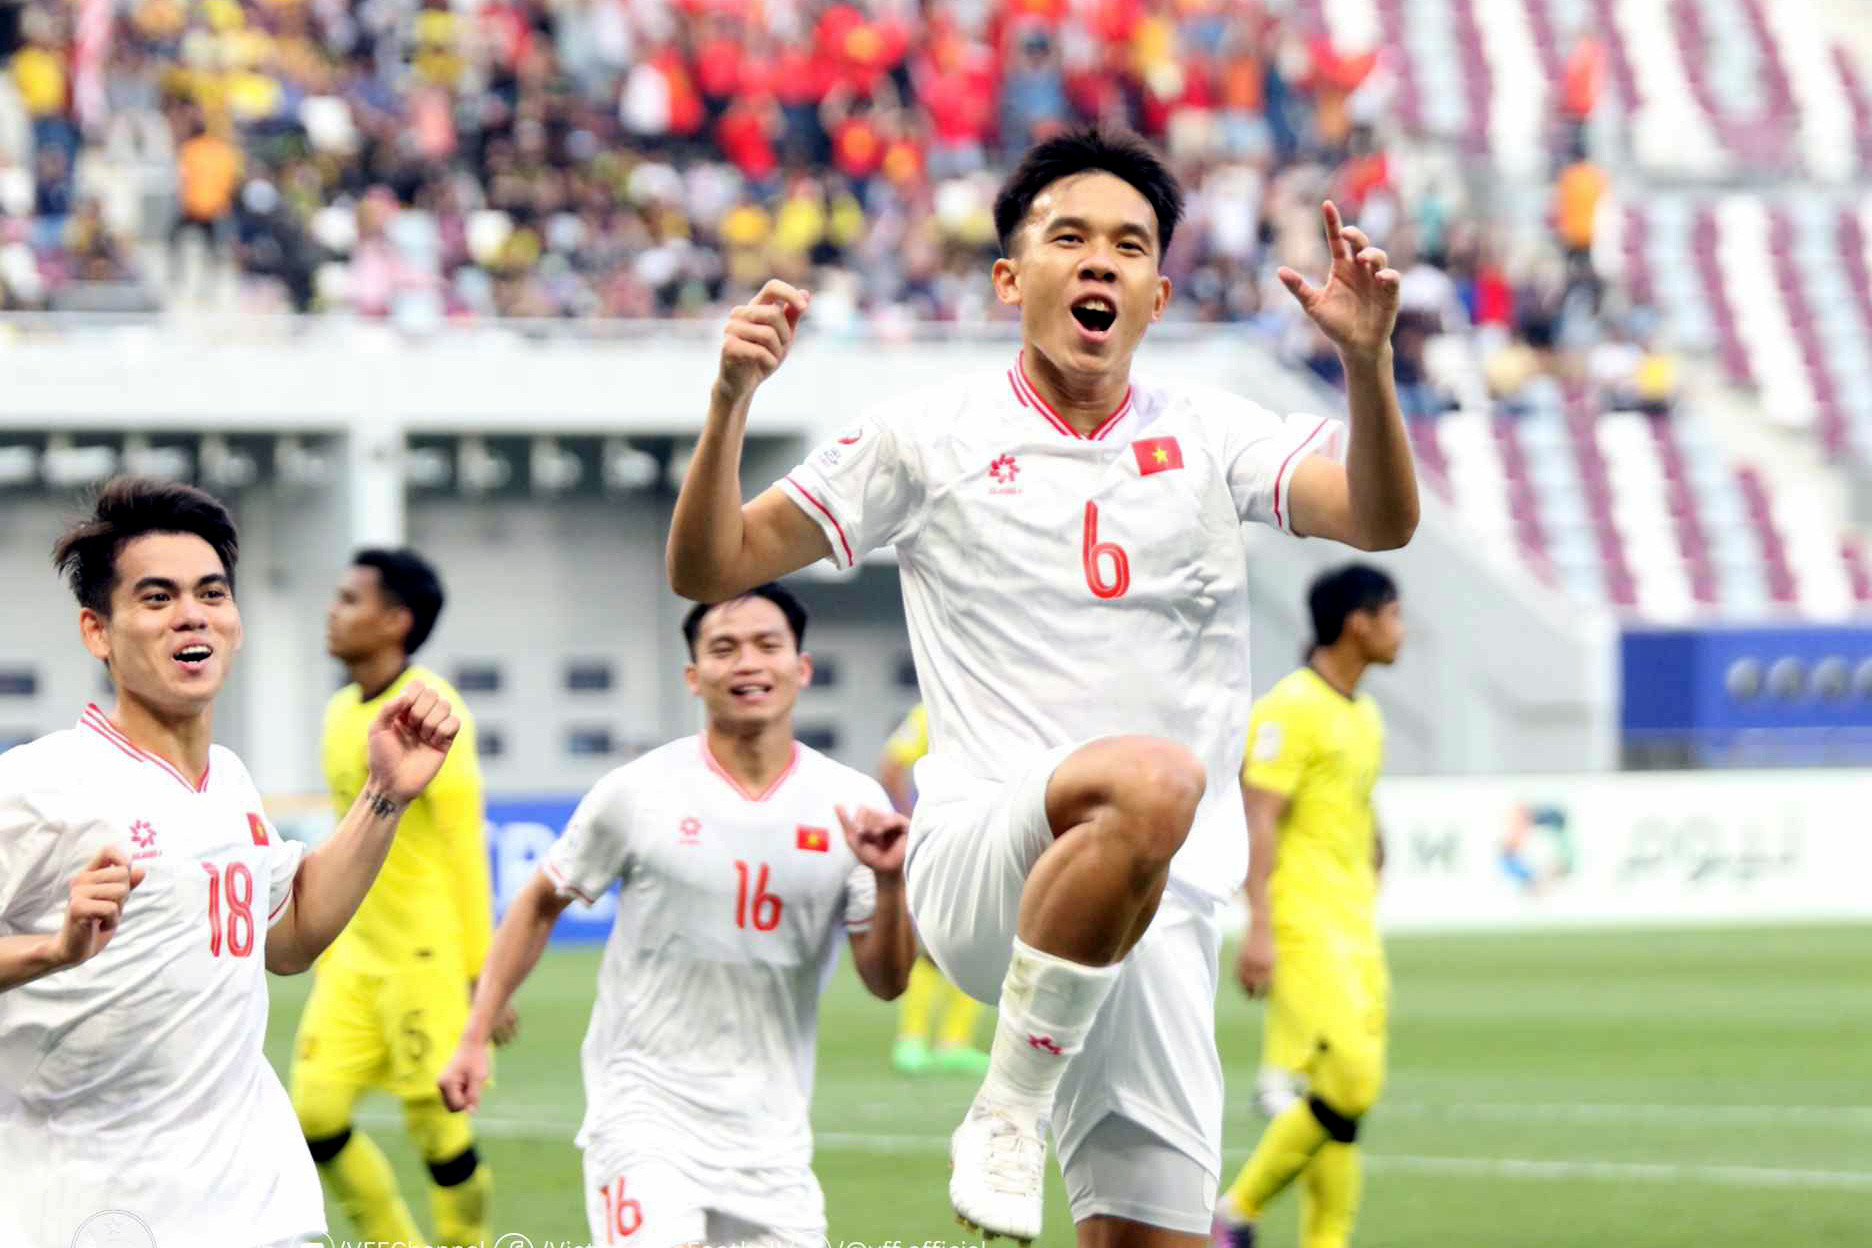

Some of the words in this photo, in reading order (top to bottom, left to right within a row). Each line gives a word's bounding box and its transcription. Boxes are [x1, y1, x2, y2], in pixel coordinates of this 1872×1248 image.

[1083, 499, 1130, 599] 6
[201, 861, 254, 957] 18
[735, 860, 783, 931] 16
[599, 1174, 643, 1245] 16
